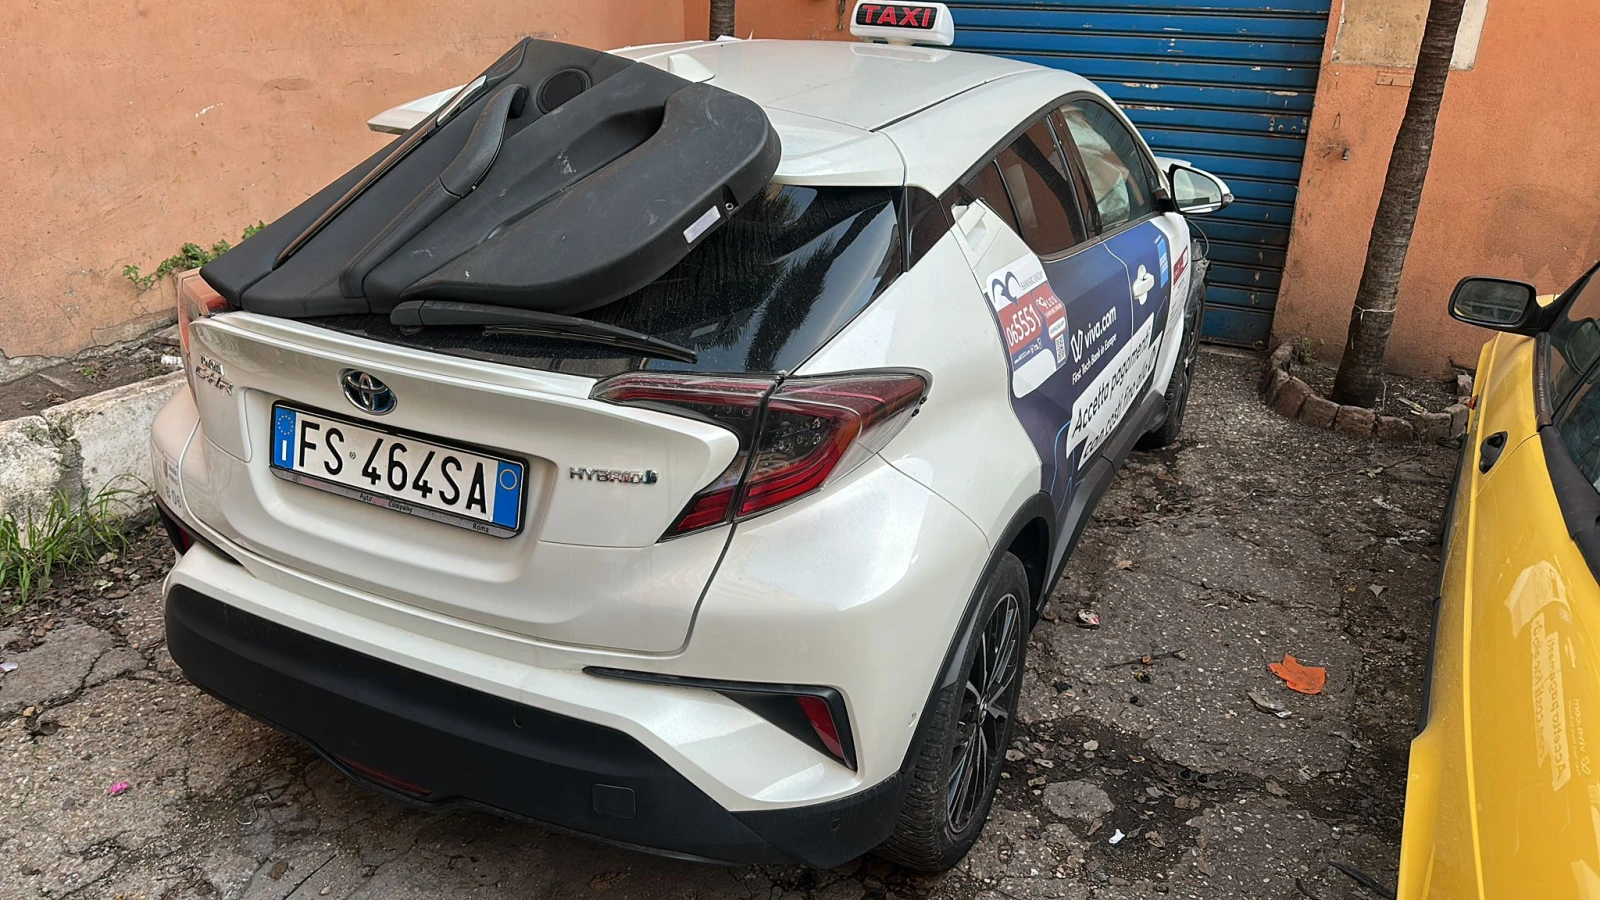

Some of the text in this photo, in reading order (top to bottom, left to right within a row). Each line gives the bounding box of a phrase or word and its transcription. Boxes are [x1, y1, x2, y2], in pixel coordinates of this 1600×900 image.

[862, 4, 932, 27] TAXI
[1006, 303, 1041, 347] 065551
[1084, 306, 1117, 349] viva.com
[1072, 333, 1117, 386] First Tech Bank in Europe
[1071, 326, 1152, 439] Accetto pagamenti
[1083, 427, 1105, 459] con
[1105, 394, 1124, 437] costi
[298, 419, 488, 515] FS 464SA
[569, 466, 644, 484] HYBRID
[388, 500, 414, 514] Company
[472, 522, 490, 533] Roma
